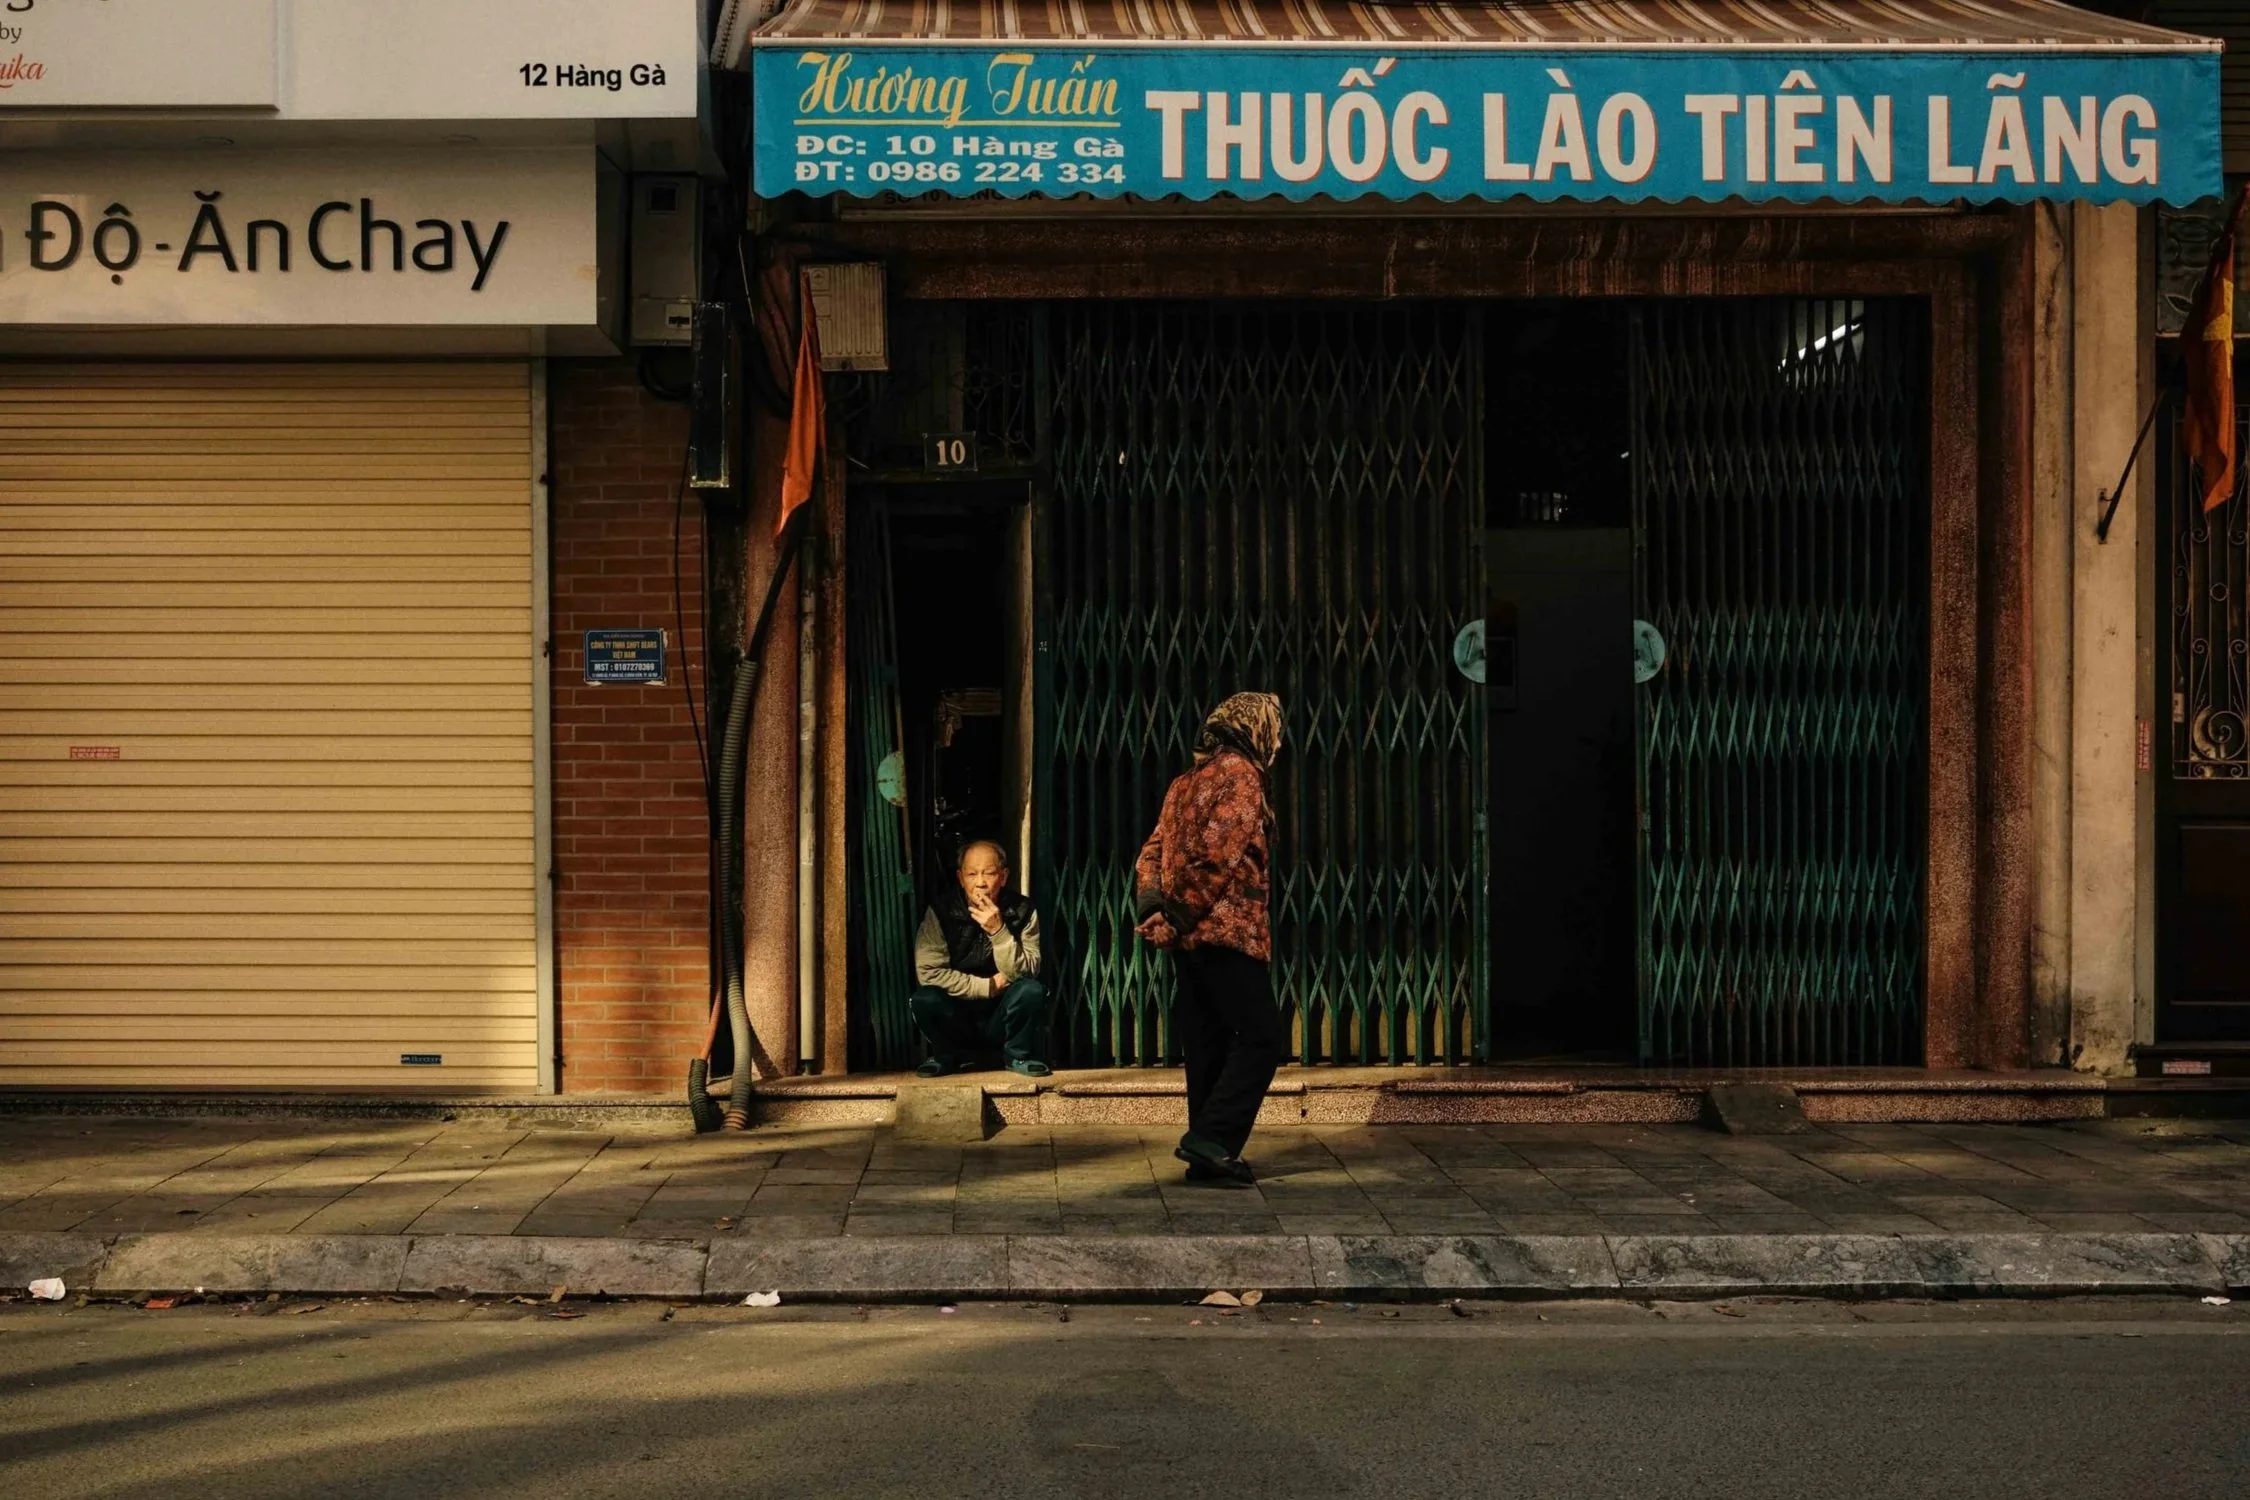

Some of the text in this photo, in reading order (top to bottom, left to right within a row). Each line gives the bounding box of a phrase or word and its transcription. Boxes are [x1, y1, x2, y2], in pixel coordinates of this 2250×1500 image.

[0, 22, 22, 44] by
[519, 63, 666, 92] 12 Hàng Gà
[796, 51, 1122, 129] Hương Tuấn
[1145, 57, 2160, 186] THUỐC LÀO TIÊN LÃNG
[795, 136, 1125, 159] ĐC: 10 Hàng Gà
[795, 161, 1126, 184] ĐT: 0986 224 334
[25, 200, 141, 286] Độ
[308, 198, 511, 292] Chay
[936, 439, 967, 466] 10
[594, 663, 609, 671] MST
